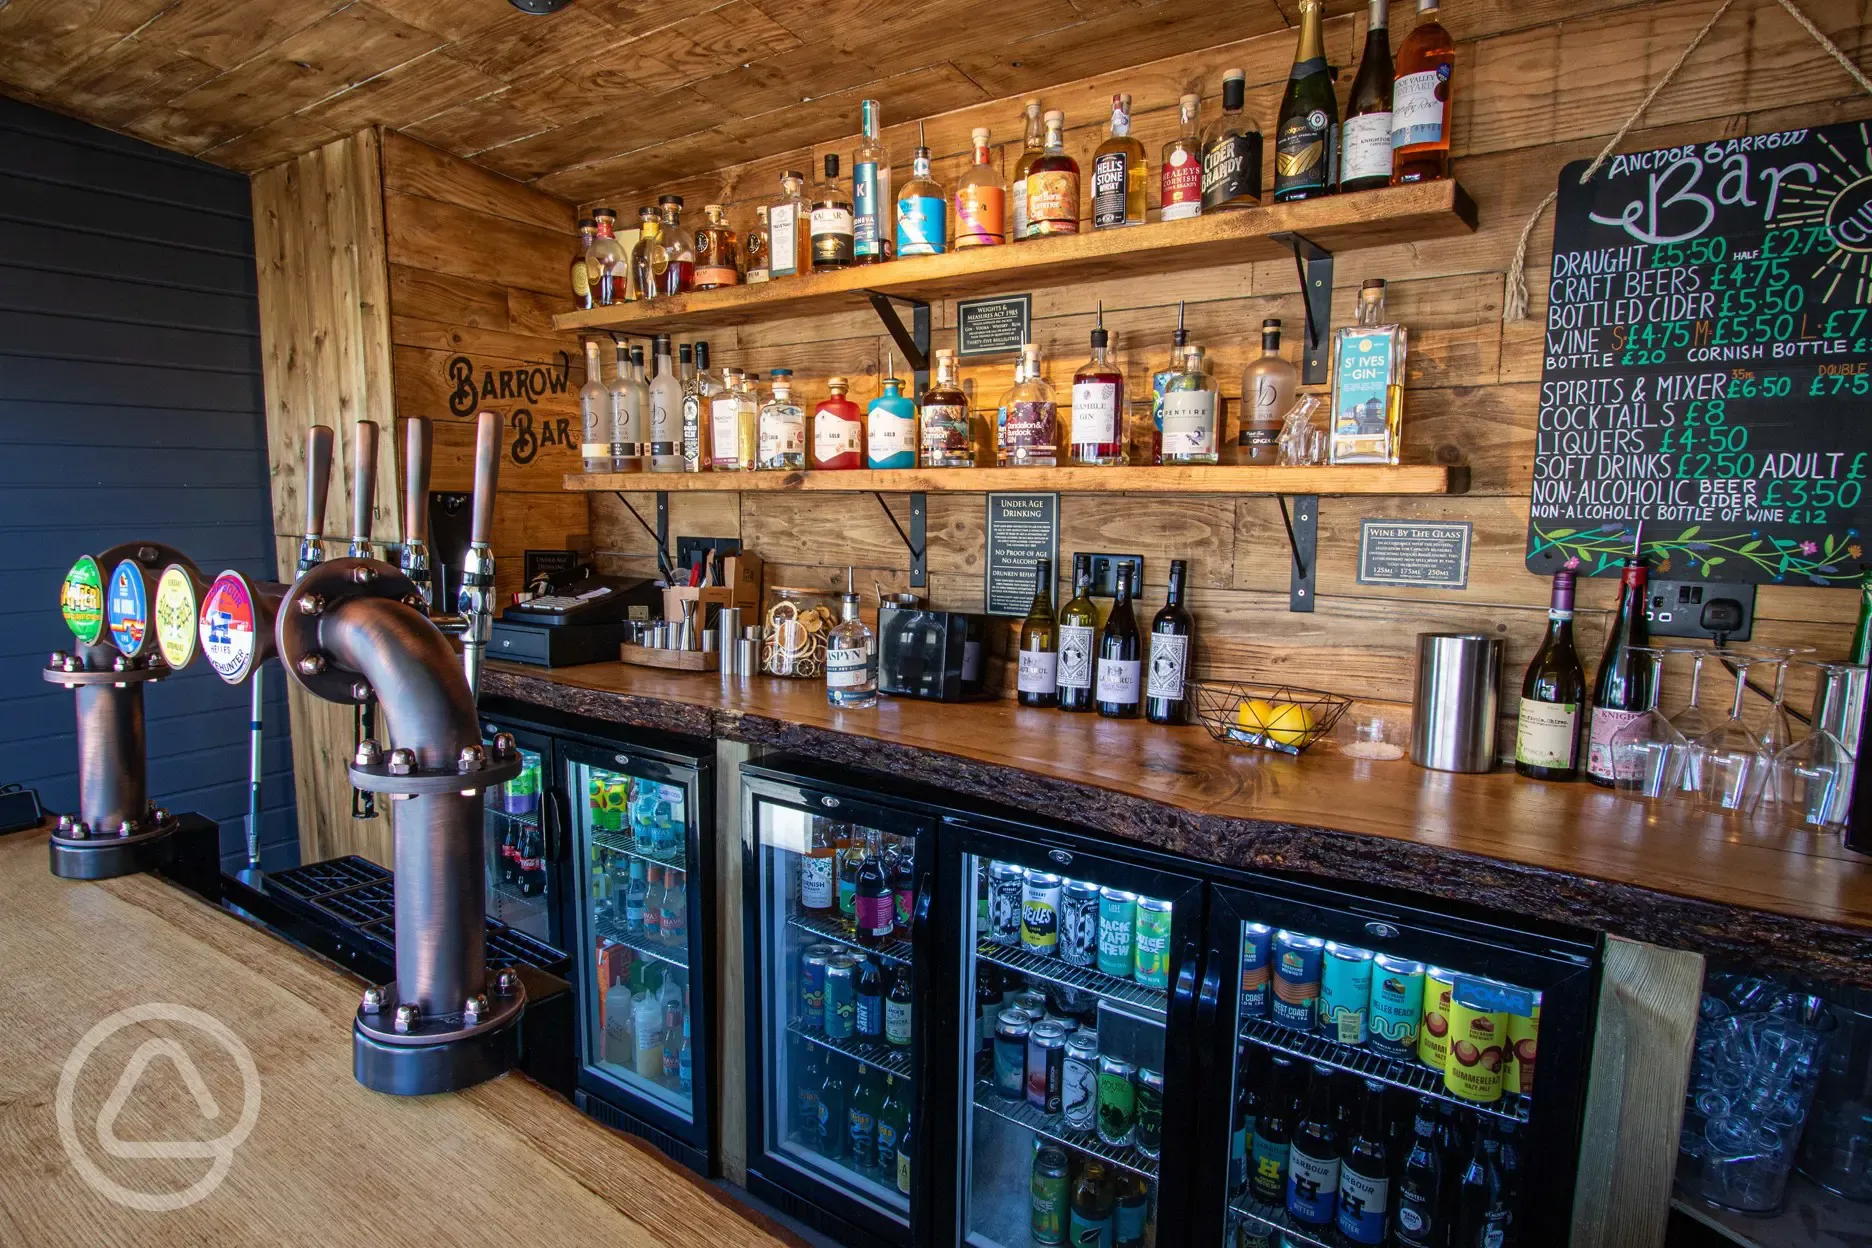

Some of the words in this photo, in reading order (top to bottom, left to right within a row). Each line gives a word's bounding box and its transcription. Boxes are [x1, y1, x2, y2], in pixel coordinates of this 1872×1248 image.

[1203, 142, 1236, 174] CIDER
[1096, 171, 1123, 186] STONE
[1201, 155, 1244, 193] BRANDY
[1588, 152, 1819, 245] Bar
[1553, 244, 1648, 279] DRAUGHT
[1733, 250, 1760, 262] HALF
[1550, 274, 1613, 305] CRAFT
[1624, 265, 1701, 299] BEERS
[1549, 300, 1643, 331] BOTTLED
[1648, 291, 1715, 324] CIDER
[1546, 327, 1601, 356] WINE
[1358, 355, 1385, 368] IVES
[1546, 353, 1614, 371] BOTTLE
[1621, 349, 1667, 366] £20
[1687, 343, 1764, 362] CORNISH
[1772, 339, 1848, 359] BOTTLE
[1351, 367, 1377, 381] GIN
[1818, 362, 1869, 377] DOUBLE
[448, 350, 570, 418] BARROW
[1540, 377, 1625, 407] SPIRITS
[1630, 376, 1647, 402] &
[1655, 373, 1727, 402] MIXER
[1539, 402, 1675, 431] COCKTAILS
[1683, 400, 1726, 427] £8
[510, 408, 578, 465] BAR
[1538, 428, 1645, 455] LIQUERS
[1534, 455, 1592, 480] SOFT
[1597, 453, 1672, 480] DRINKS
[1758, 452, 1845, 480] ADULT
[1532, 479, 1690, 505] NON-ALCOHOLIC
[1699, 479, 1757, 494] BEER
[1698, 494, 1758, 508] CIDER
[1001, 499, 1029, 508] UNDER
[1028, 499, 1044, 508] AGE
[1003, 509, 1042, 518] DRINKING
[1531, 504, 1651, 520] NON-ALCOHOLIC
[1657, 506, 1715, 522] BOTTLE
[1720, 507, 1744, 523] OF
[1745, 508, 1784, 523] WINE
[1788, 509, 1828, 525] £12
[1370, 528, 1395, 537] WINE
[1397, 529, 1409, 538] BY
[1411, 529, 1430, 539] THE
[1431, 529, 1461, 539] GLASS
[1001, 557, 1012, 565] NO
[1006, 549, 1026, 557] PROOF
[1035, 550, 1048, 558] AGE
[992, 570, 1019, 578] DRUNKEN
[210, 645, 232, 655] HELLES
[1022, 904, 1052, 926] HELLES
[1099, 916, 1131, 932] BACK
[1099, 927, 1130, 945] YARD
[1099, 939, 1130, 957] BREW
[1245, 993, 1264, 1002] COAST
[1459, 983, 1526, 1010] POLAR
[1288, 1006, 1309, 1017] COAST
